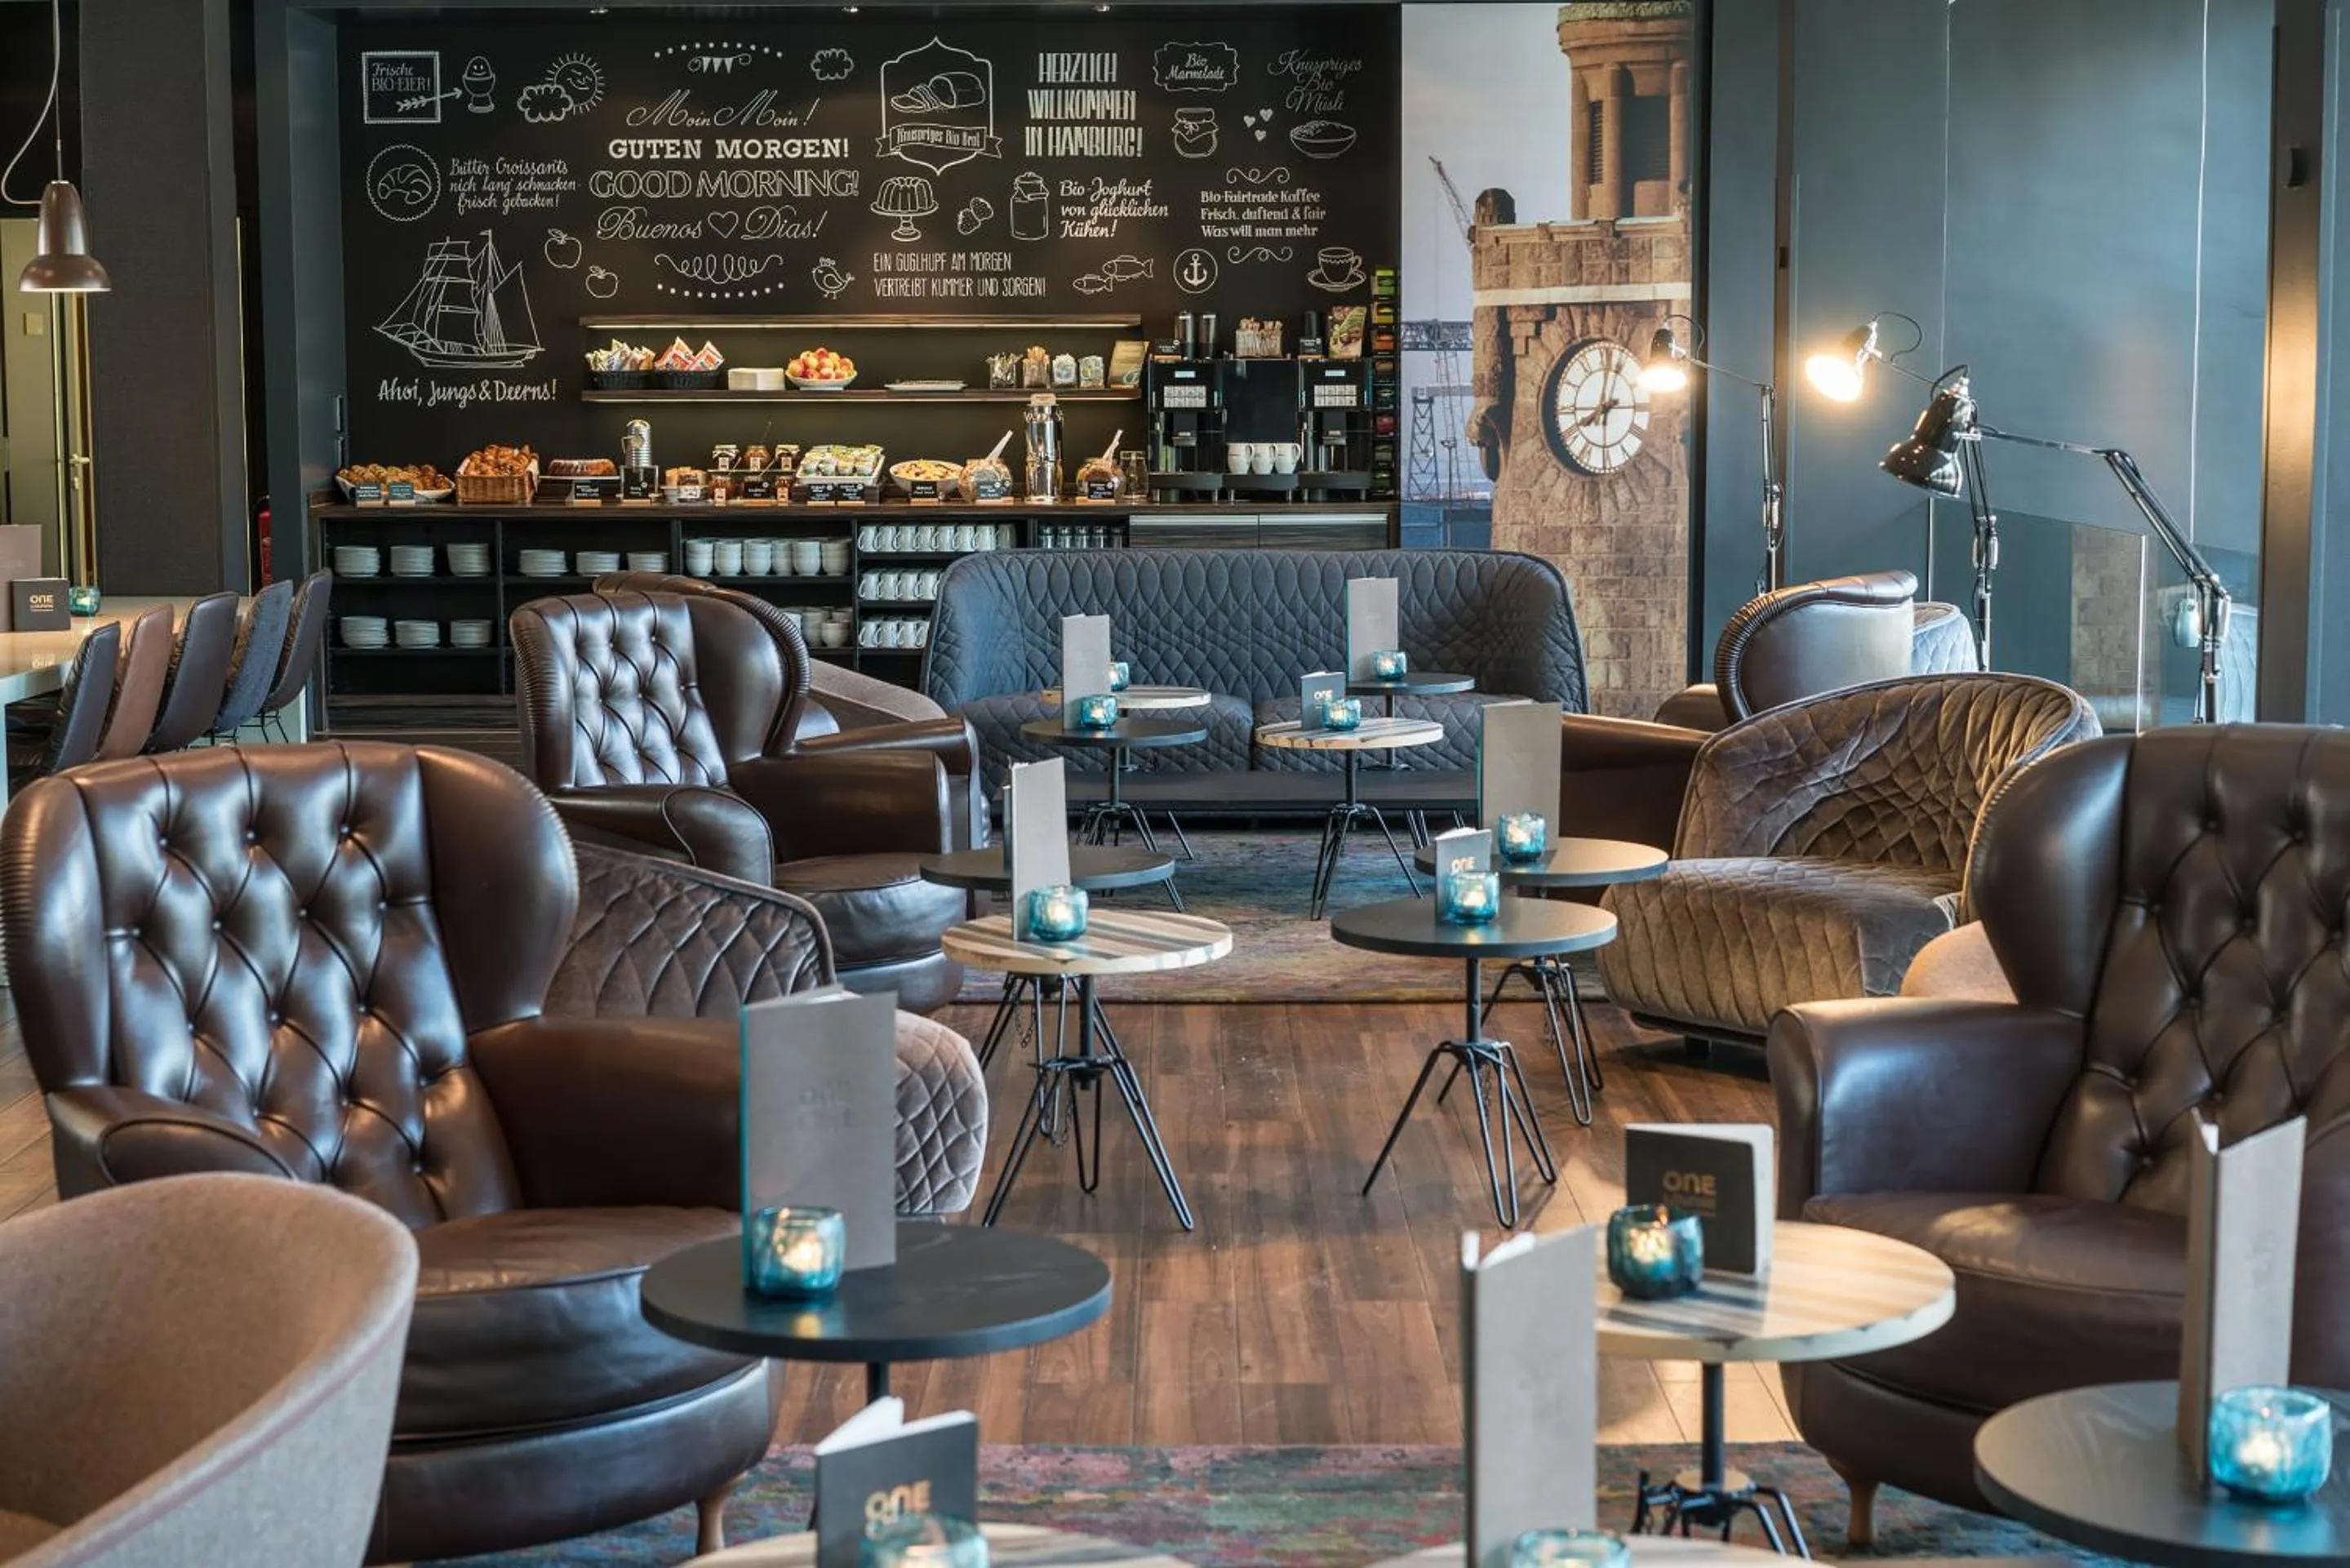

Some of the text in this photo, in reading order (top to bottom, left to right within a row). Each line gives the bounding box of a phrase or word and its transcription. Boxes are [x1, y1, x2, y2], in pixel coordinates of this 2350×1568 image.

[371, 62, 414, 78] Frische
[1038, 52, 1117, 83] HERZLICH
[1185, 52, 1207, 69] Bio
[1165, 64, 1224, 81] Marmelade
[626, 89, 711, 127] Moin
[1027, 89, 1136, 121] WILLKOMMEN
[609, 138, 849, 159] GUTEN MORGEN!
[1025, 127, 1143, 158] IN HAMBURG!
[449, 176, 477, 192] nich
[588, 169, 860, 198] GOOD MORNING!
[458, 192, 560, 215] frisch gebacken!
[1281, 188, 1321, 203] Kaffee
[1060, 198, 1170, 225] von glücklichen
[1242, 207, 1288, 220] duftend
[1291, 207, 1301, 220] &
[1304, 206, 1326, 220] fair
[597, 205, 828, 240] Buenos Dias!
[1059, 219, 1117, 238] Kühen!
[1201, 224, 1319, 238] Was will man mehr
[873, 251, 1012, 272] EIN GUGLHUPF AM MORGEN
[873, 278, 928, 298] VERTREIBT
[931, 278, 974, 297] KUMMER
[977, 278, 999, 297] UND
[378, 377, 558, 408] Ahoi, Jungs & Deerns!
